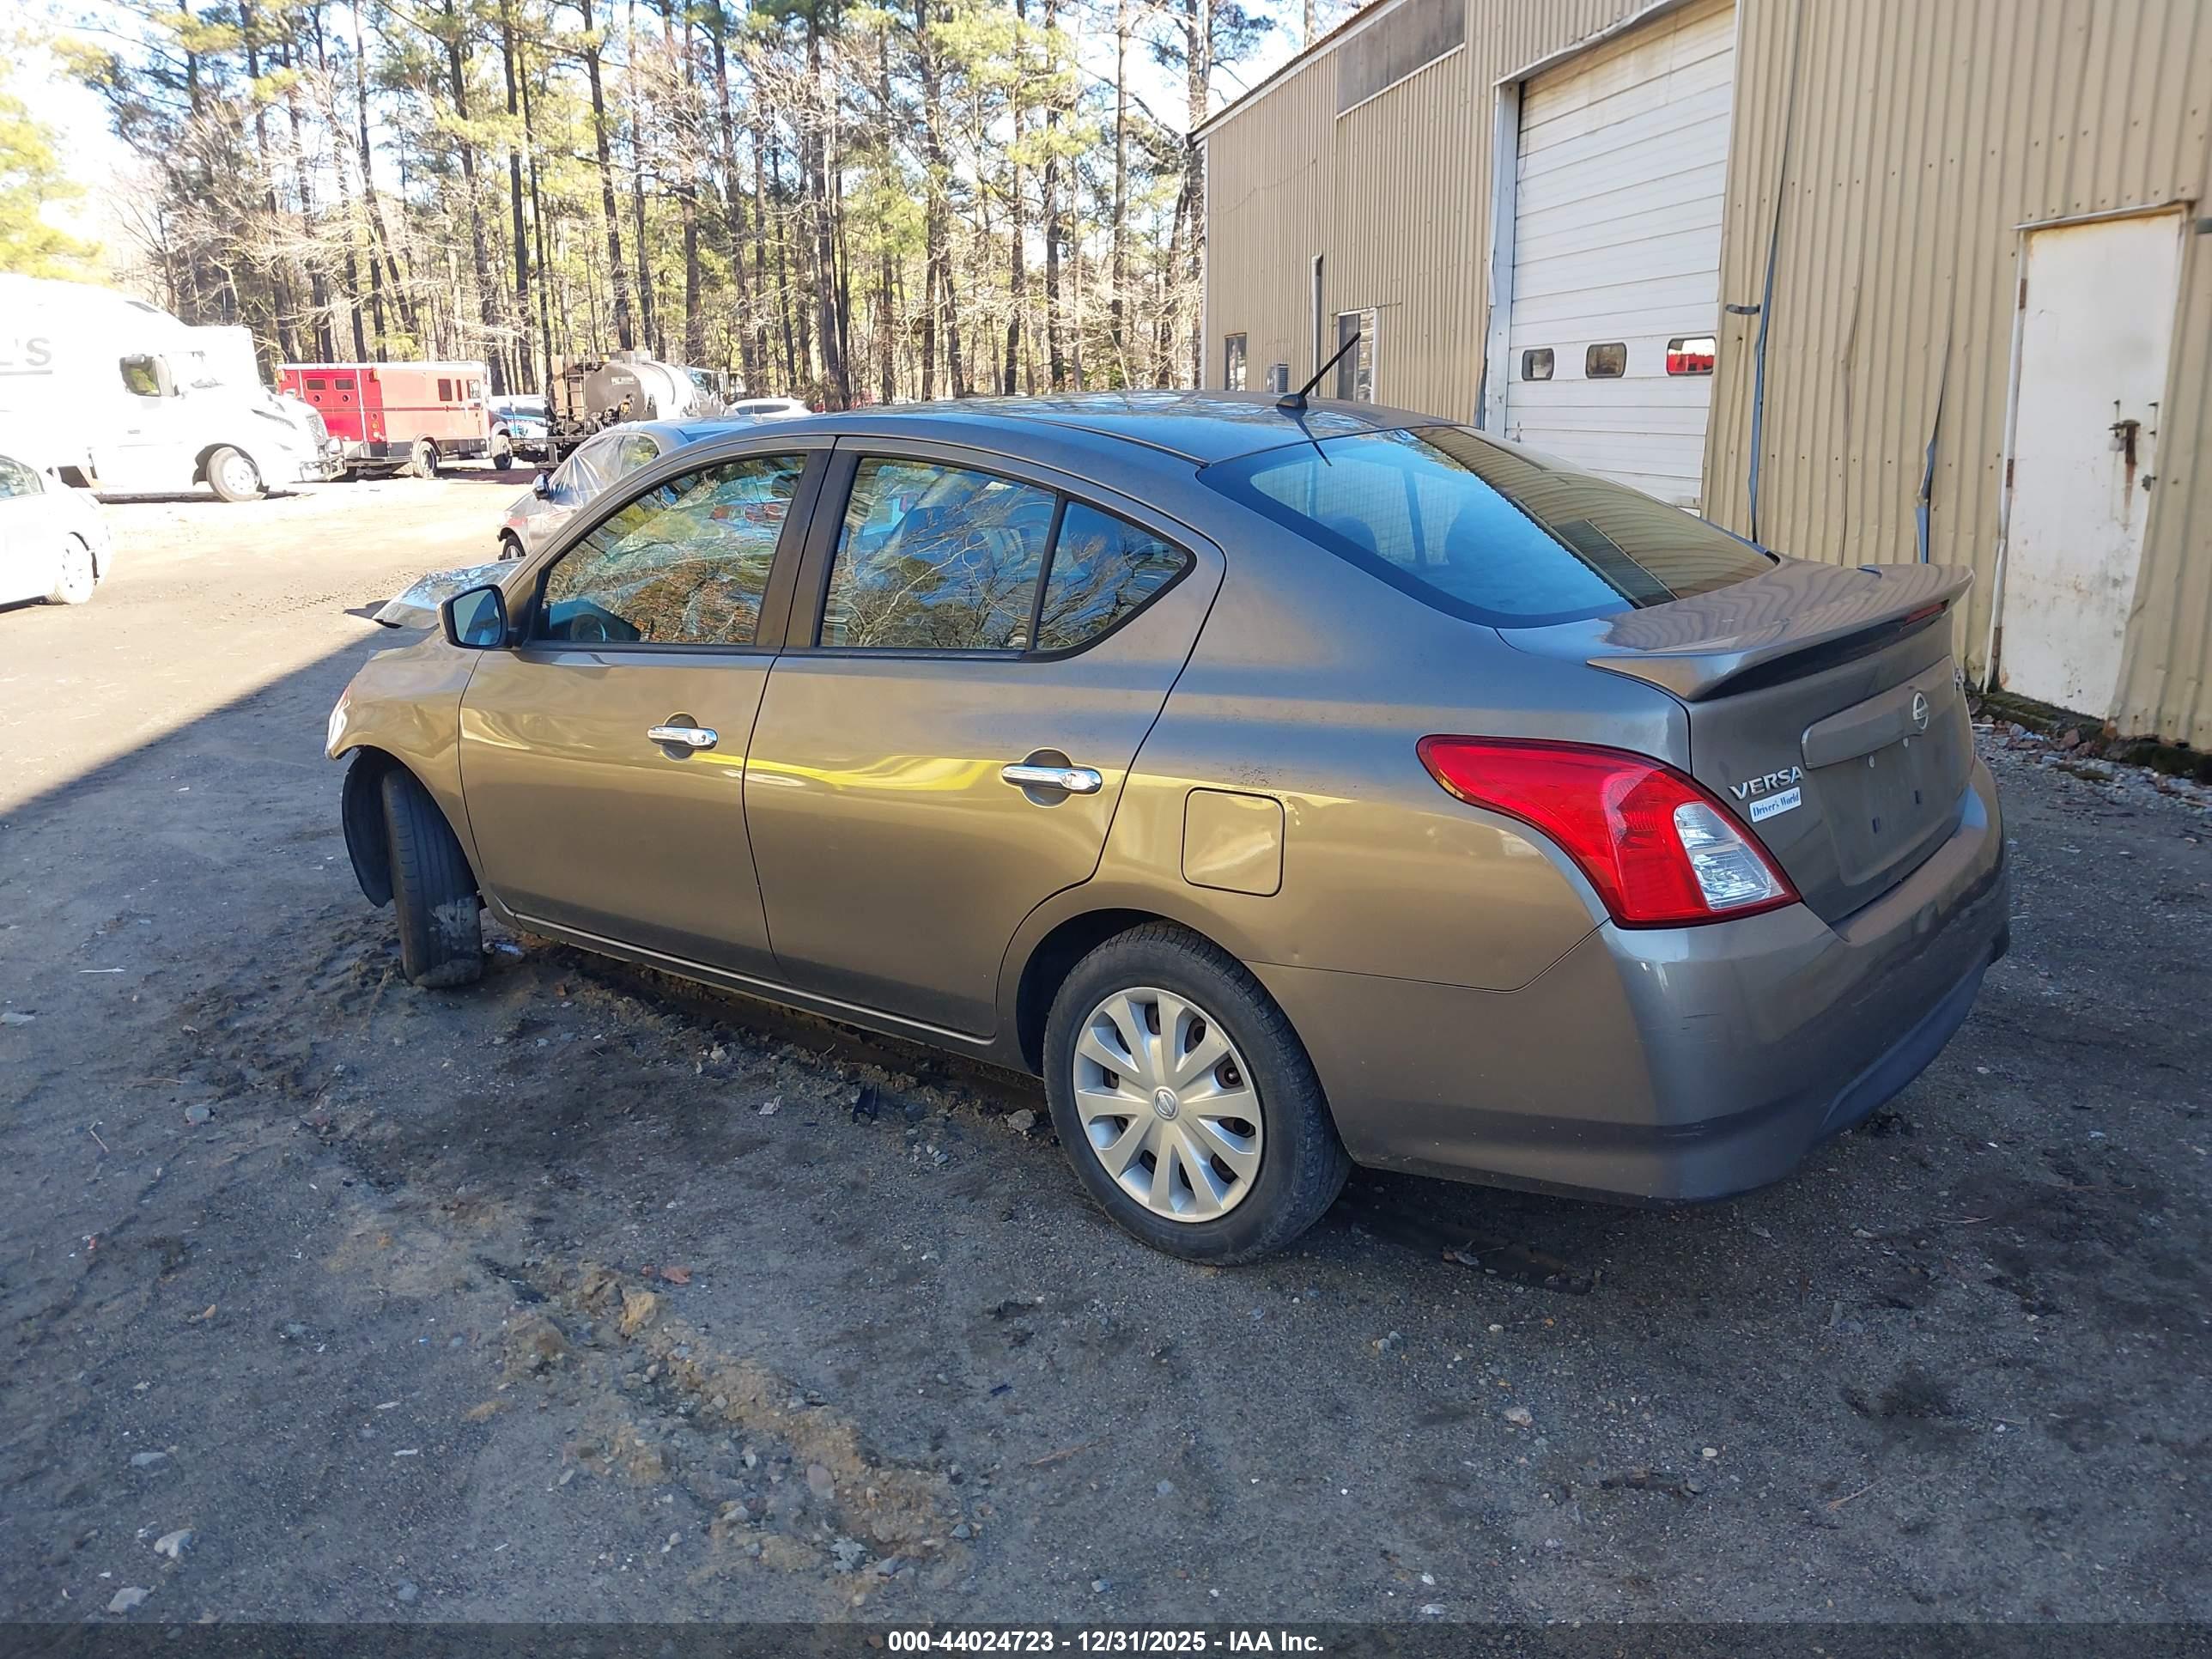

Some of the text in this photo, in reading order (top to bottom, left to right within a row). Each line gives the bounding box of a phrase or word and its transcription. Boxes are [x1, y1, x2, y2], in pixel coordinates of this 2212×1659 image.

[1728, 765, 1804, 800] VERSA
[1753, 792, 1799, 817] Driver's World
